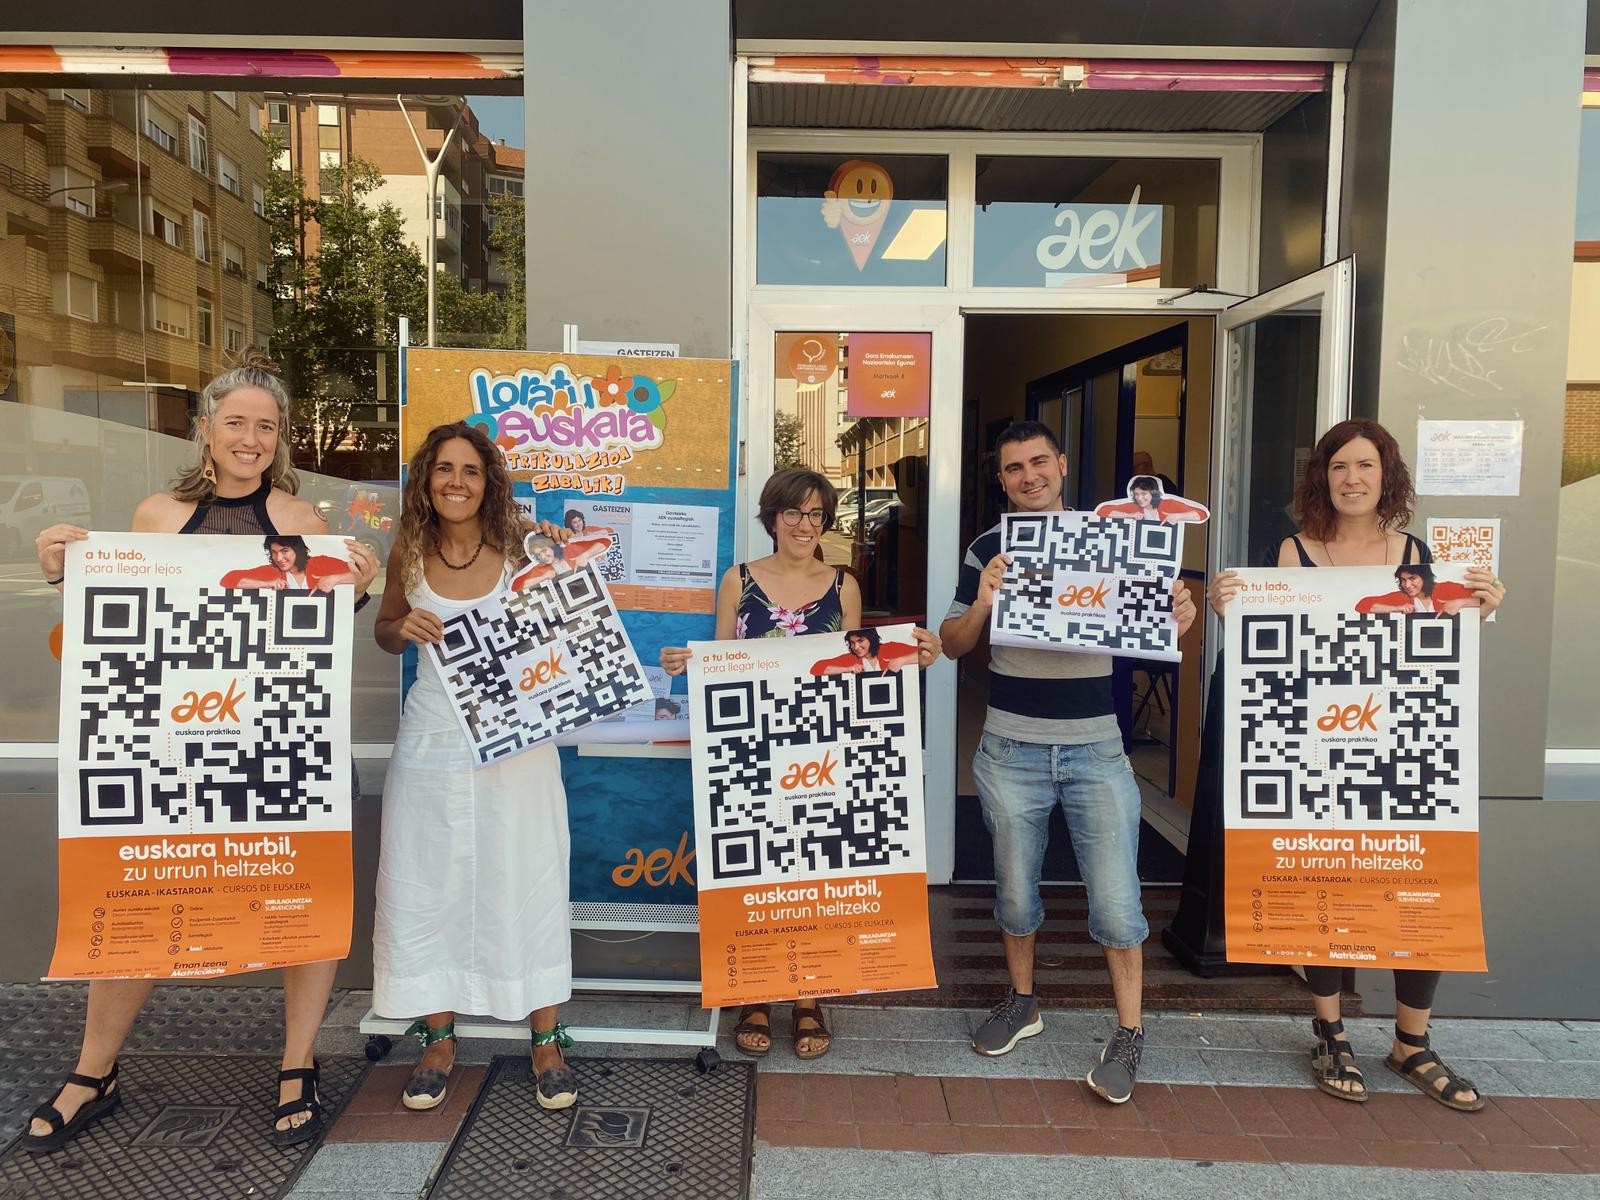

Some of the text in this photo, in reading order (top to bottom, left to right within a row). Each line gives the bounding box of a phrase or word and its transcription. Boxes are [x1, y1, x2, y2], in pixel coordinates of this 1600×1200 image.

[1036, 184, 1156, 270] aek
[851, 231, 871, 244] aek
[476, 369, 595, 414] Loratu
[880, 388, 896, 399] aek
[497, 407, 655, 448] euskara
[592, 505, 631, 513] GASTEIZEN
[85, 549, 146, 562] a tu lado,
[1453, 548, 1471, 561] aek
[85, 563, 182, 576] para llegar lejos
[1058, 577, 1111, 609] aek
[1252, 583, 1261, 591] tu
[1265, 581, 1291, 592] lado,
[1242, 593, 1322, 605] para llegar lejos
[712, 654, 722, 662] tu
[726, 651, 751, 661] lado,
[519, 646, 567, 692] aek
[703, 660, 779, 675] para llegar lejos
[171, 678, 246, 724] aek
[1317, 692, 1382, 732] aek
[206, 728, 241, 737] praktikoa
[1347, 736, 1378, 744] praktikoa
[780, 750, 838, 790] aek
[808, 791, 836, 800] praktikoa
[119, 836, 296, 860] euskara hurbil,
[1272, 833, 1426, 855] euskara hurbil,
[612, 831, 697, 887] aek
[1275, 853, 1424, 871] zu urrun heltzeko
[123, 858, 294, 882] zu urrun heltzeko
[222, 884, 258, 893] CURSOS
[260, 884, 271, 892] DE
[273, 882, 311, 891] EUSKERA
[1359, 877, 1390, 885] CURSOS
[743, 879, 882, 906] euskara hurbil,
[747, 898, 881, 923] zu urrun heltzeko
[1329, 943, 1352, 951] Eman
[1353, 943, 1376, 951] izena
[173, 960, 228, 970] Eman izena
